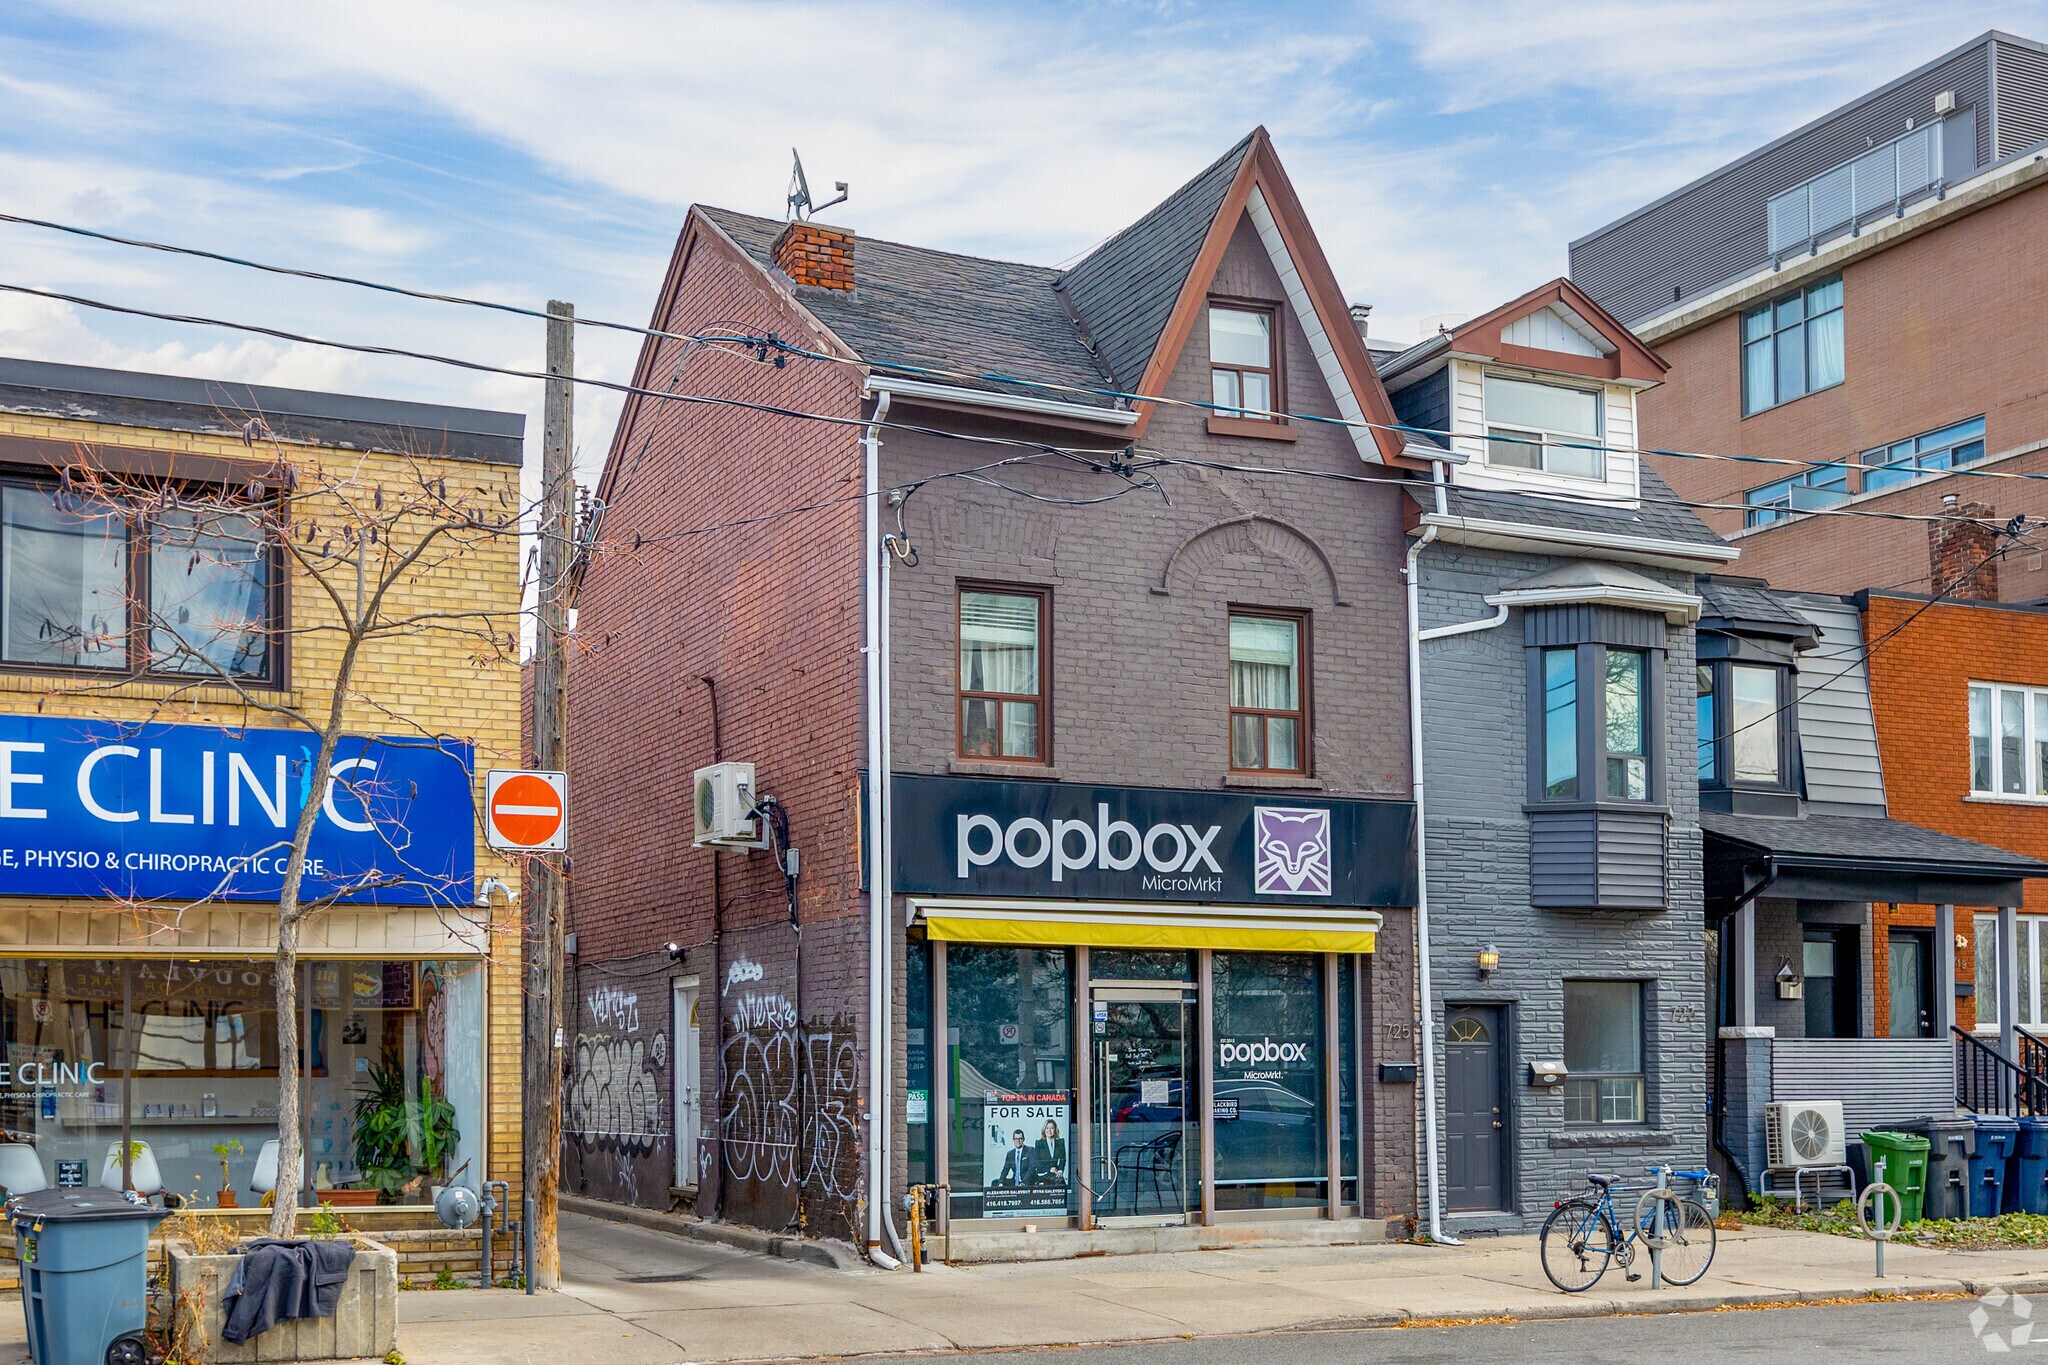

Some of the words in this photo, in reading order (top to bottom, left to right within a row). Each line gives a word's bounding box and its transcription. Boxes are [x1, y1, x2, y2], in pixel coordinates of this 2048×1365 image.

[0, 741, 48, 820] E
[957, 803, 1223, 882] popbox
[0, 849, 19, 870] E,
[25, 849, 100, 869] PHYSIO
[105, 852, 120, 870] &
[125, 853, 270, 875] CHIROPRACTIC
[274, 857, 325, 877] CRE
[1142, 874, 1223, 892] MicroMrkt
[1383, 1023, 1411, 1039] 725
[1220, 1037, 1307, 1067] popbox
[0, 1063, 11, 1085] E
[18, 1060, 105, 1086] CLINIC
[991, 1107, 1020, 1118] FOR
[1026, 1106, 1063, 1118] SALE
